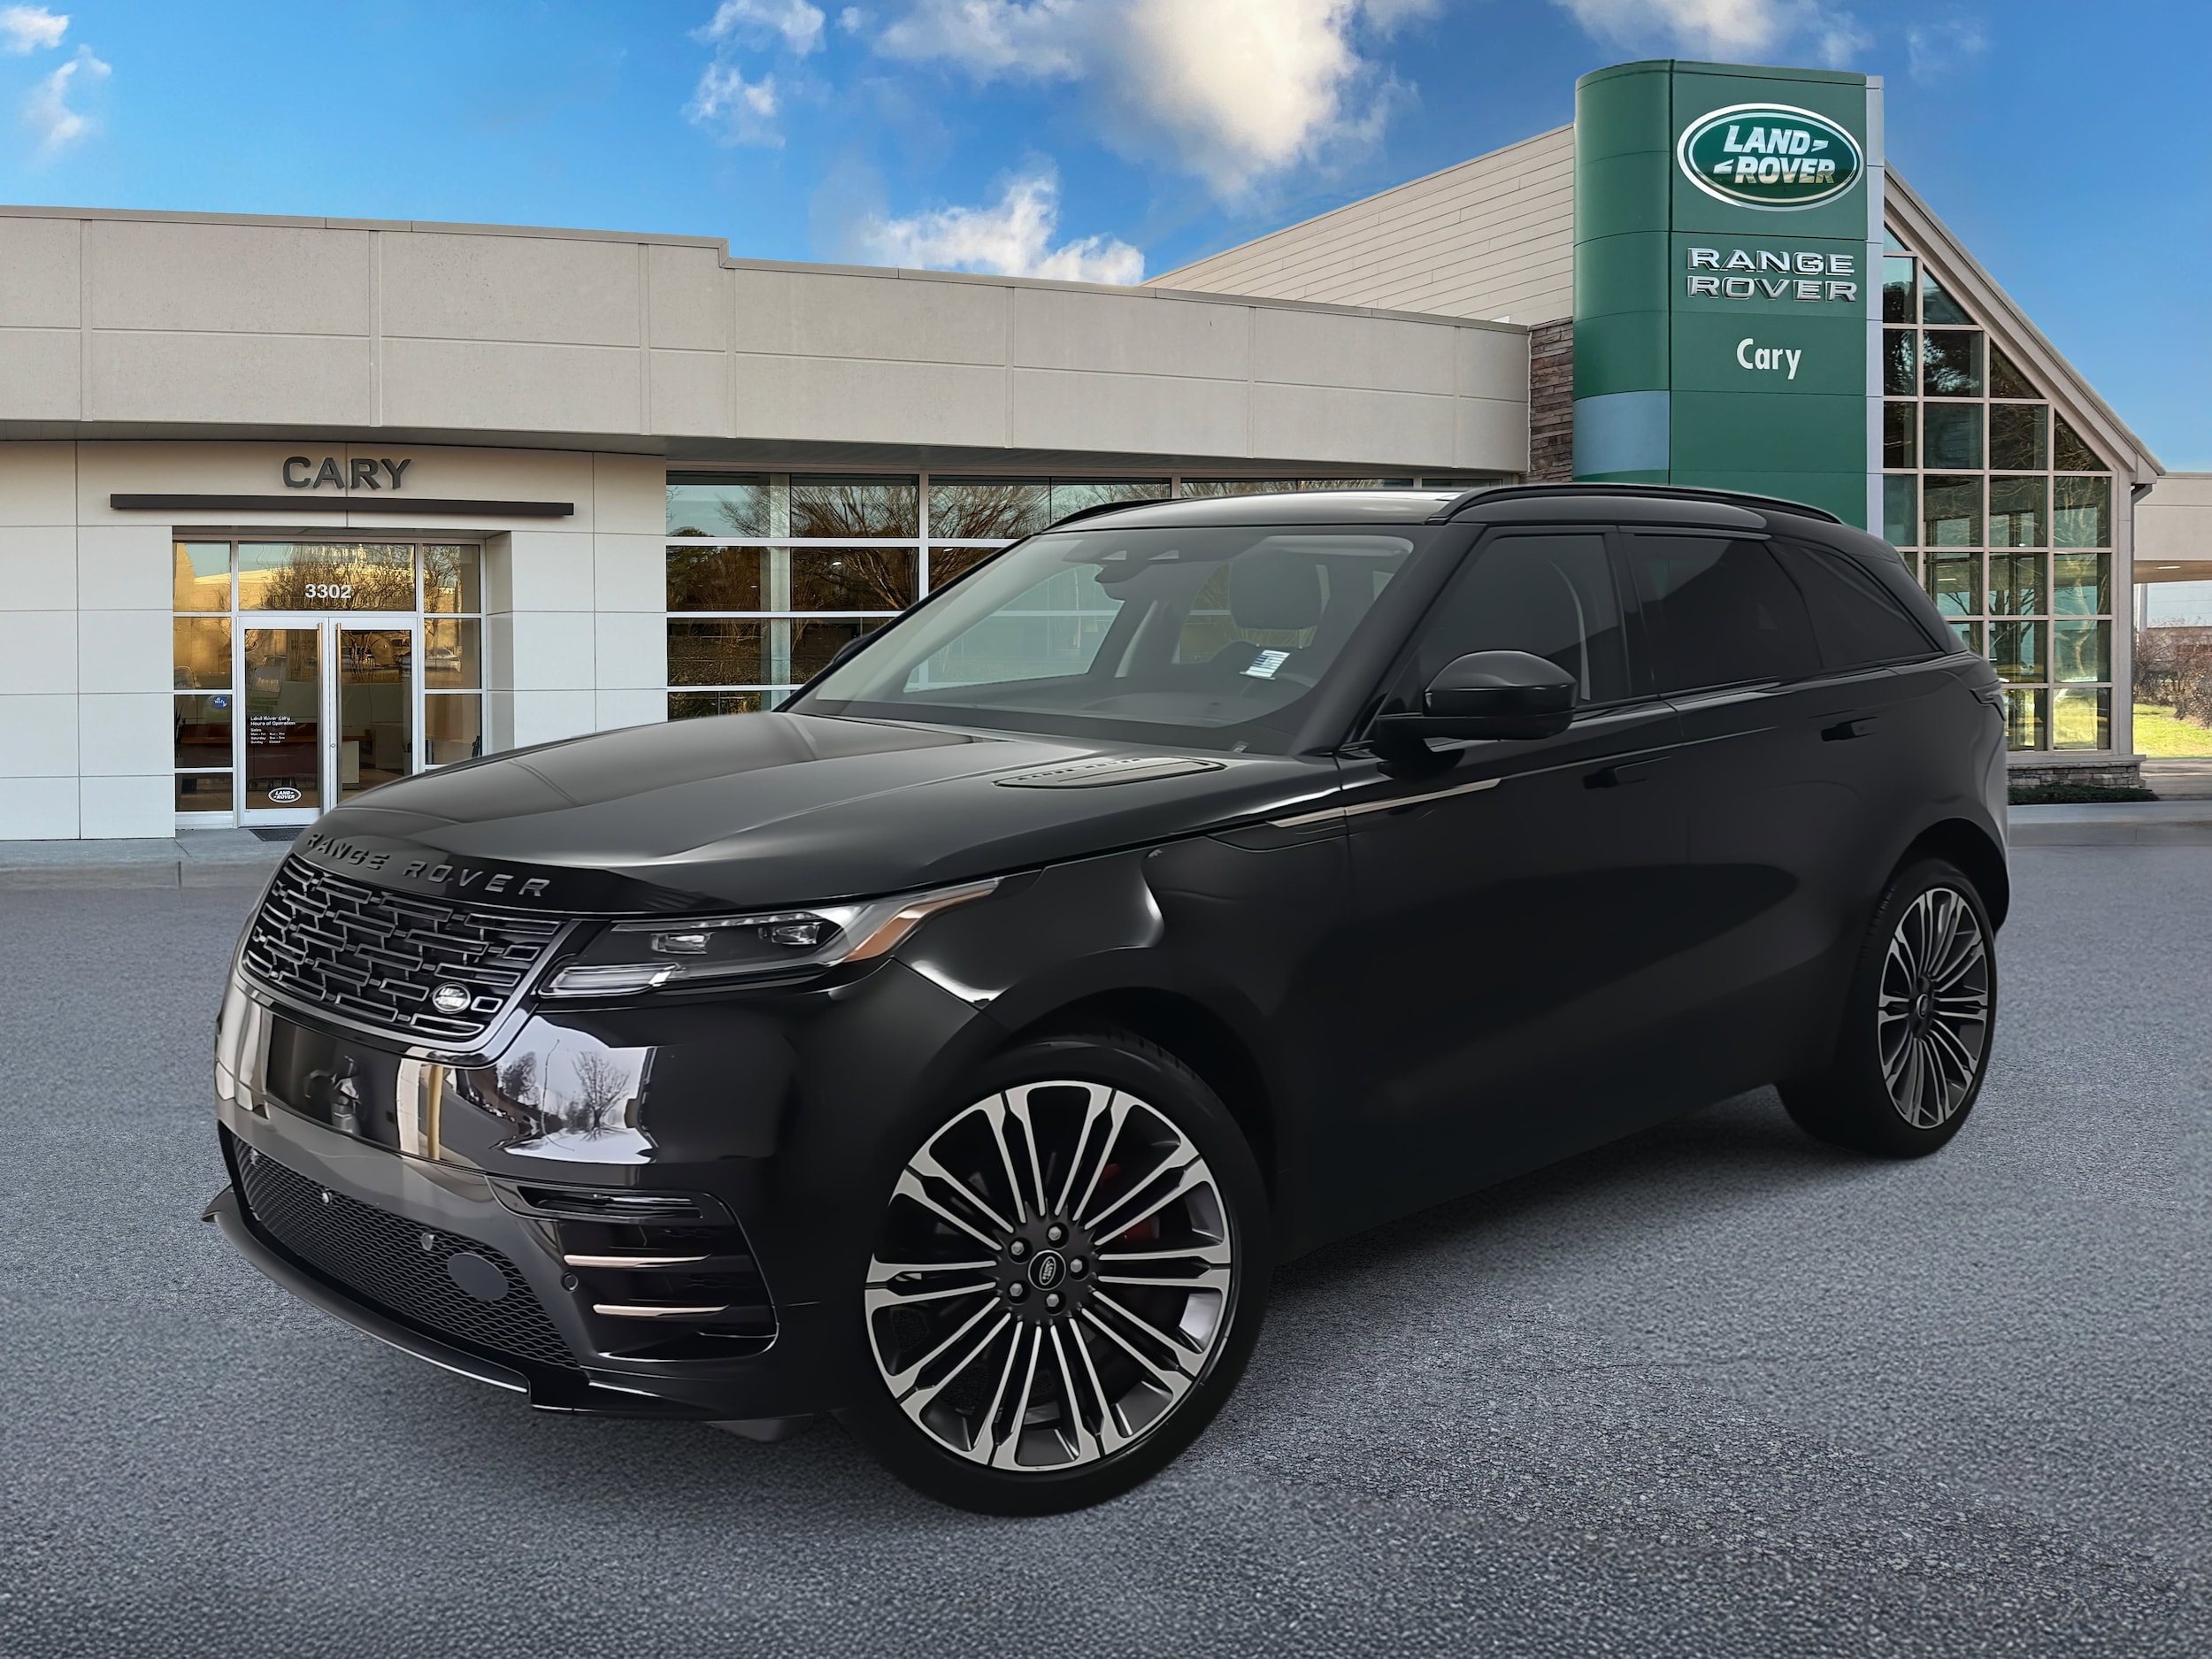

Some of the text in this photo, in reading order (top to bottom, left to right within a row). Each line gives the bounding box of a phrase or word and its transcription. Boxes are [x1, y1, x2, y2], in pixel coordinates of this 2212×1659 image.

[1722, 124, 1812, 156] LAND
[1733, 155, 1836, 184] ROVER
[1686, 247, 1855, 276] RANGE
[1686, 275, 1858, 303] ROVER
[1736, 337, 1802, 380] Cary
[282, 456, 412, 490] CARY
[304, 583, 352, 599] 3302
[306, 833, 550, 897] RANGE ROVER
